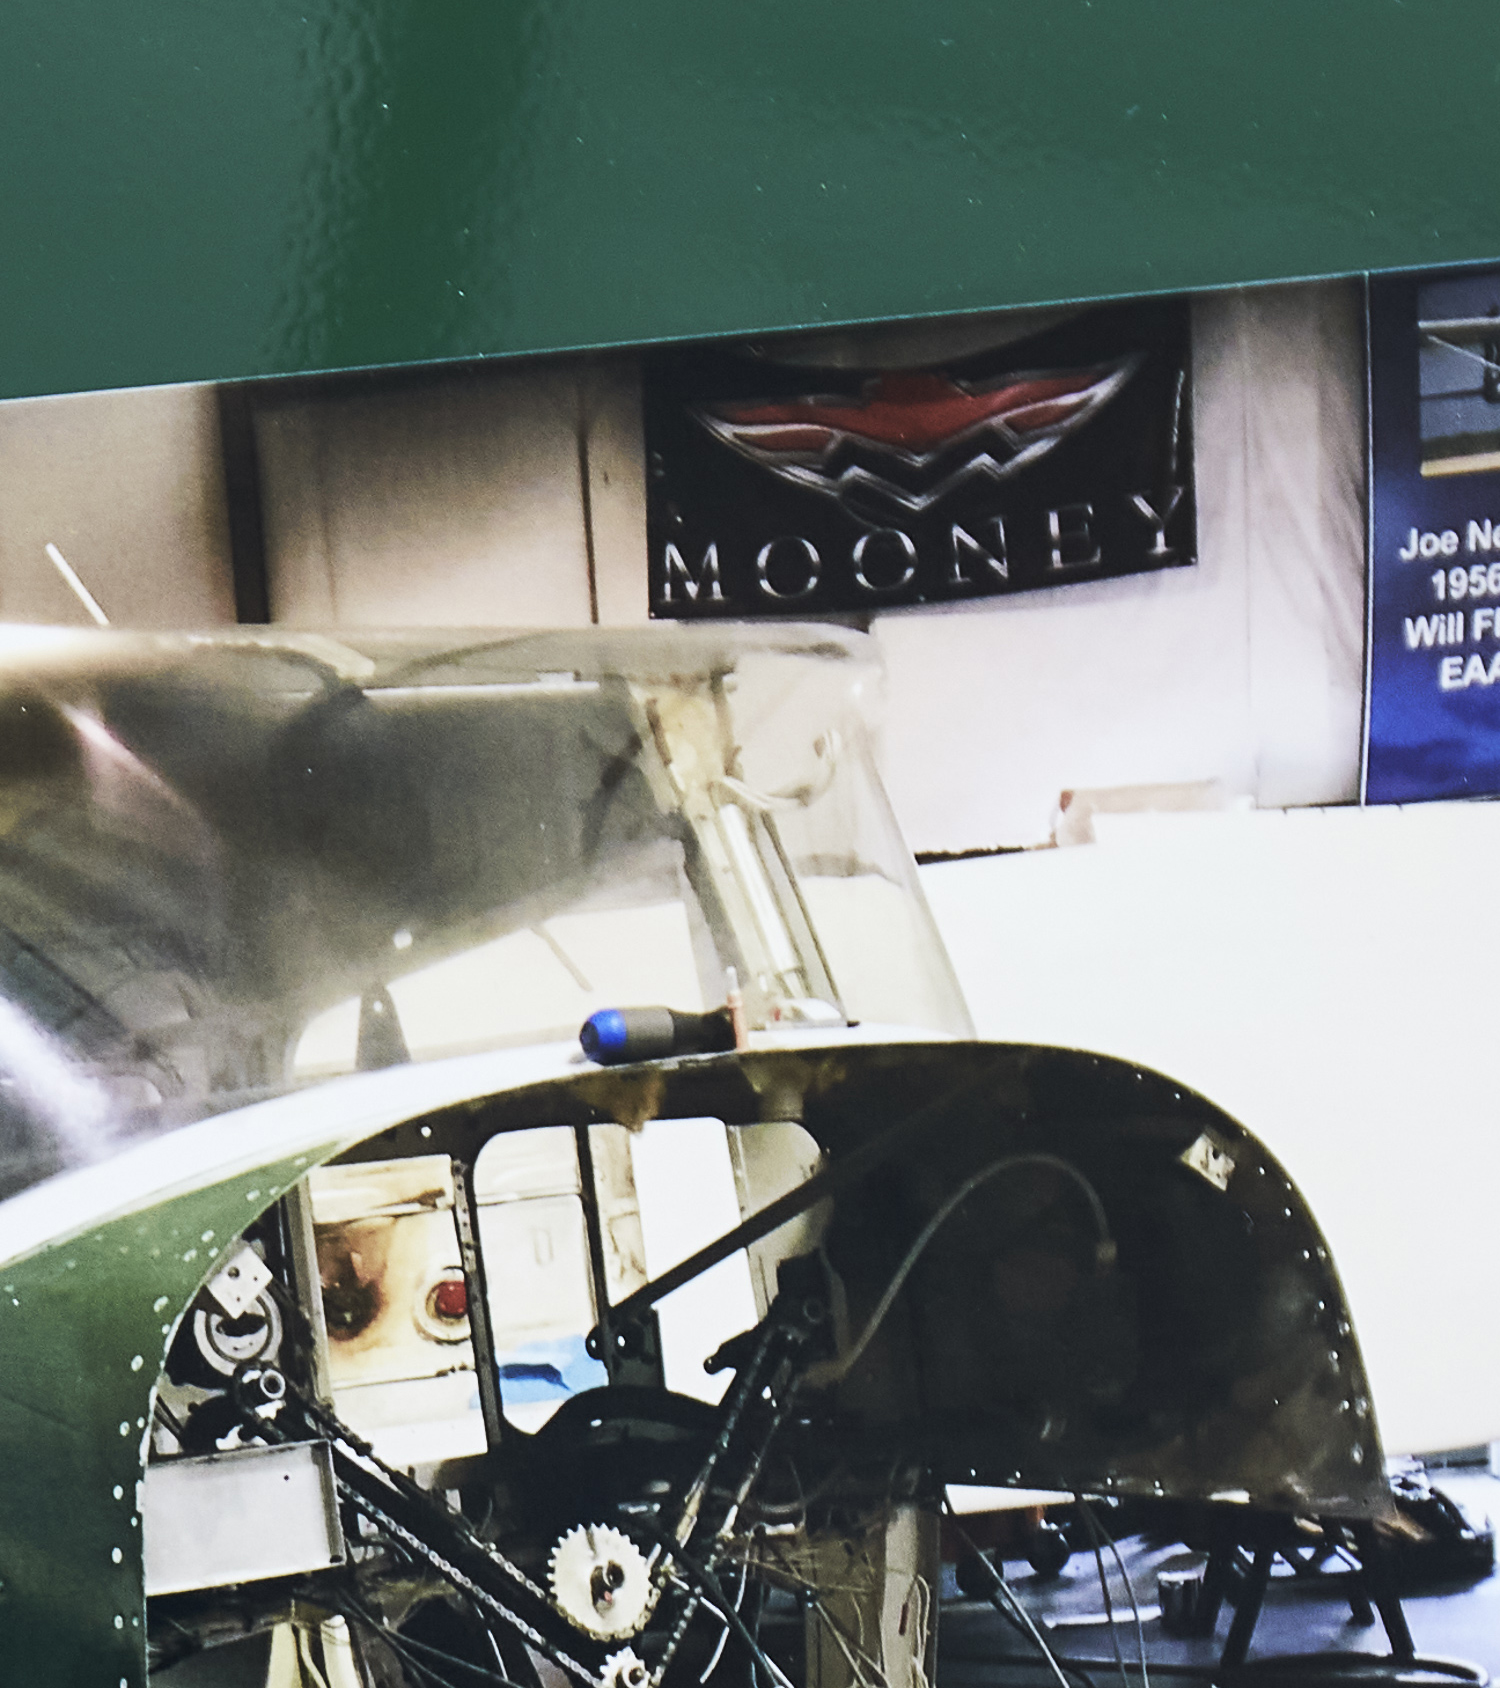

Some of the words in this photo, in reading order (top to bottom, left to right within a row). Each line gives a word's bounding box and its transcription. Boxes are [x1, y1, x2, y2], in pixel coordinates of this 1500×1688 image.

[662, 485, 1185, 602] MOONEY
[1399, 526, 1460, 561] Joe
[1404, 610, 1464, 649] Will
